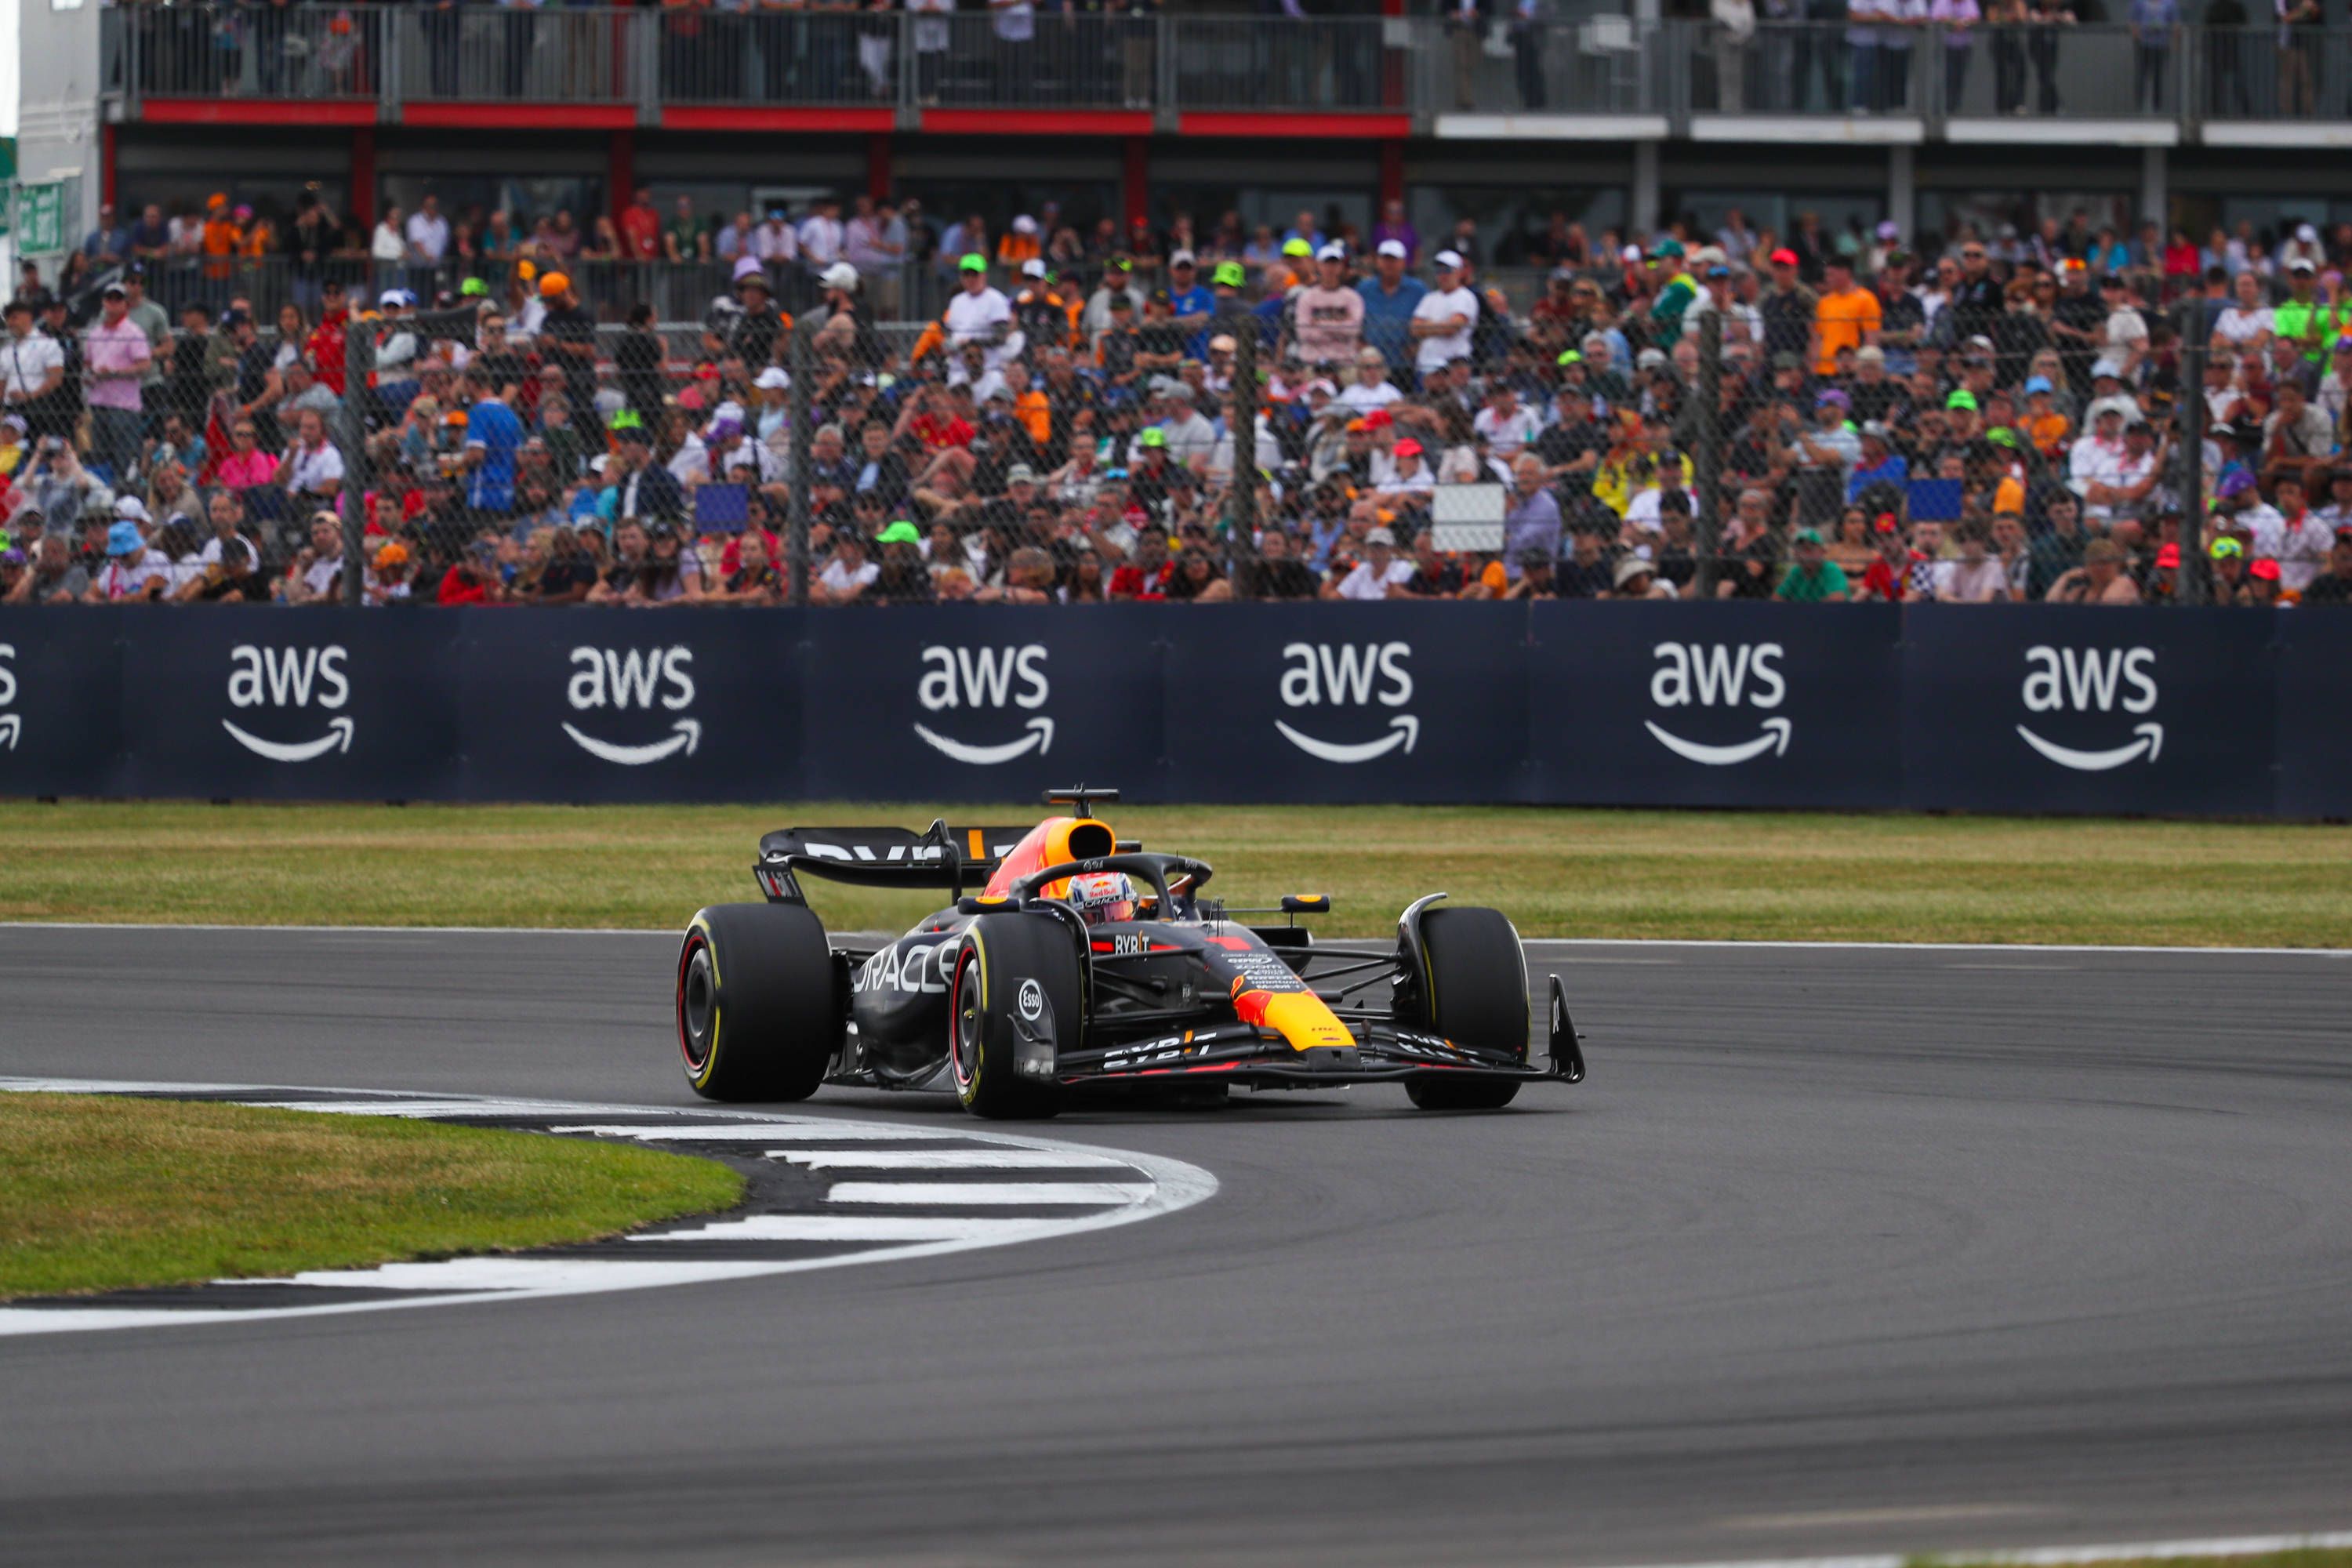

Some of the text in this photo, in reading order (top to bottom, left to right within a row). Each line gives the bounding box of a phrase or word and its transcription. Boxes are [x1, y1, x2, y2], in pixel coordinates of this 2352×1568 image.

[227, 645, 349, 708] aws
[568, 646, 695, 710] aws
[918, 644, 1049, 710] aws
[1280, 642, 1413, 706] aws
[1650, 642, 1785, 708] aws
[2023, 646, 2158, 713] aws
